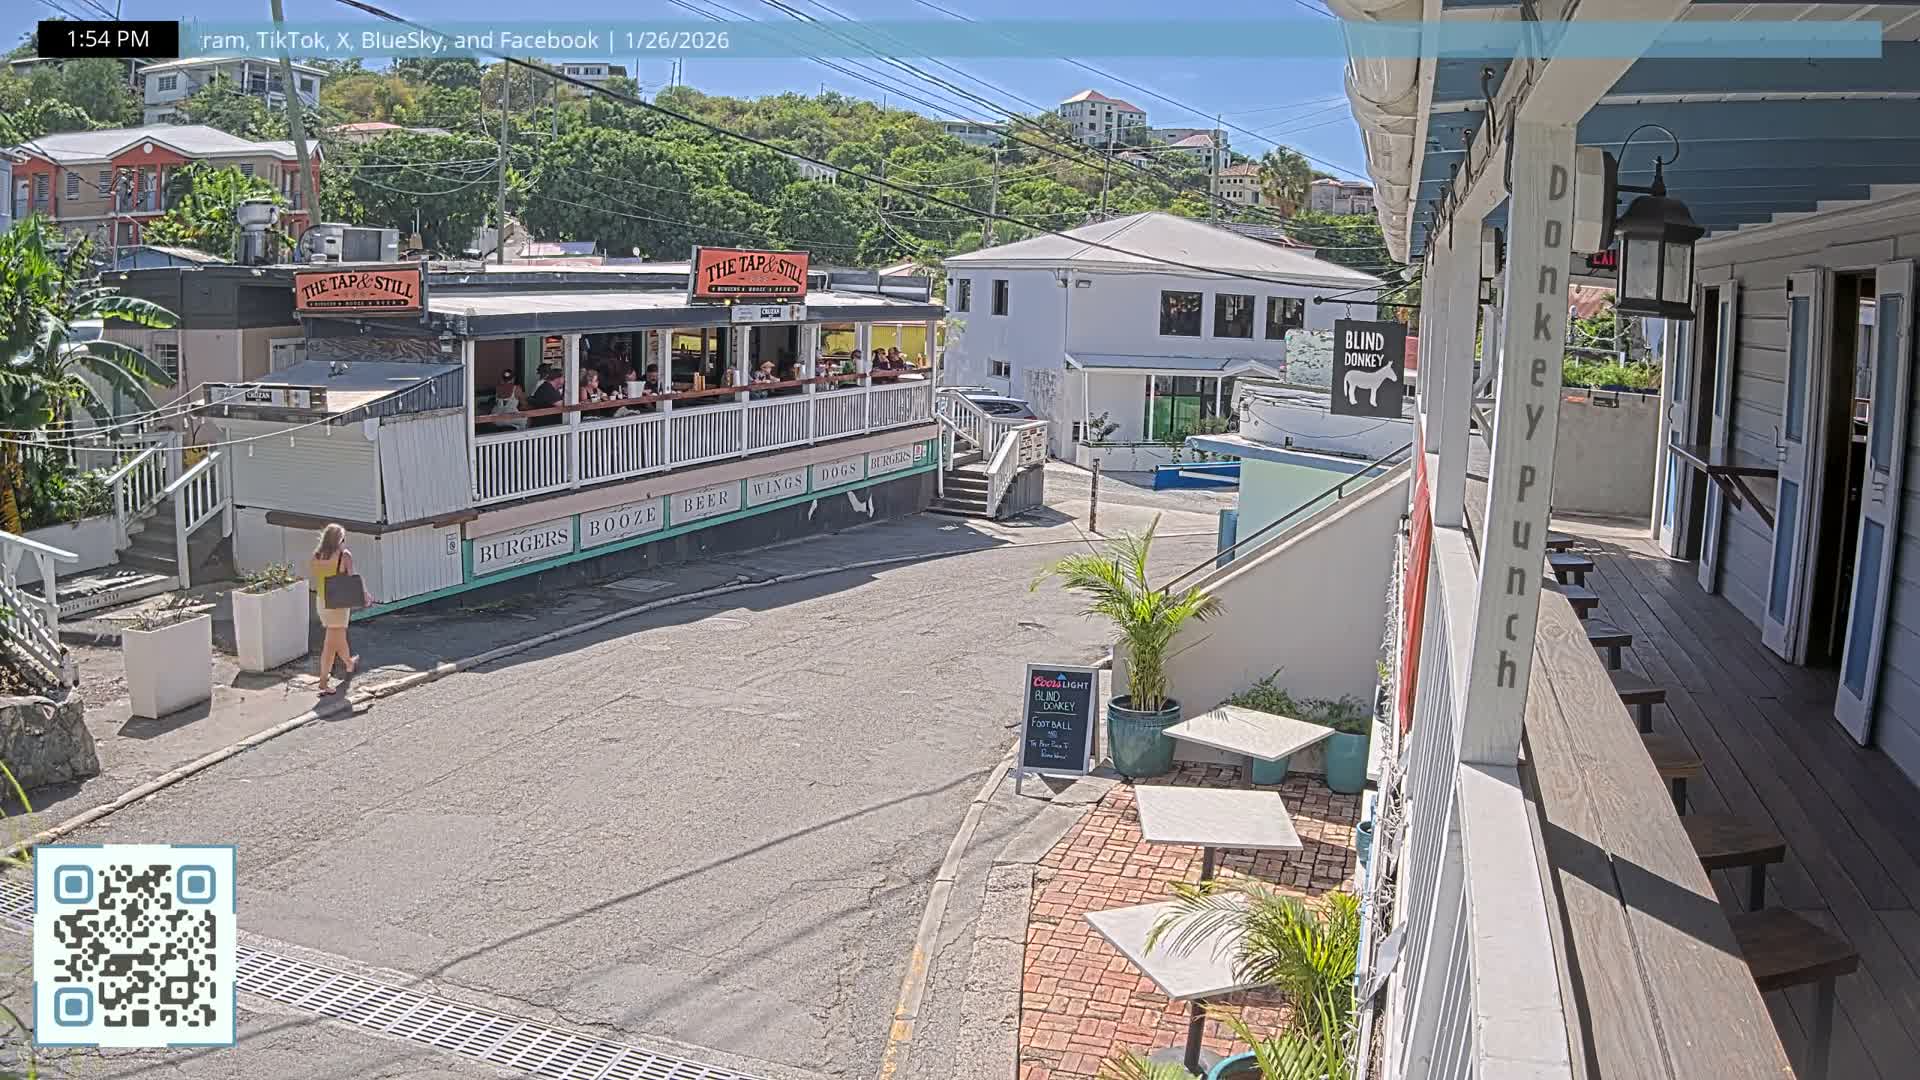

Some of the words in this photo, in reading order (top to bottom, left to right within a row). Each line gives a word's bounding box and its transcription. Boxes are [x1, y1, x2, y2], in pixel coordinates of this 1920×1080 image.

[706, 258, 737, 283] THE
[738, 255, 765, 273] TAP
[777, 259, 803, 285] STILL
[301, 279, 329, 300] THE
[329, 274, 358, 290] TAP
[374, 275, 414, 299] STILL
[1345, 330, 1385, 351] BLIND
[1344, 352, 1385, 368] DONKEY
[246, 391, 271, 399] CRUZAN
[870, 450, 912, 470] BURGERS
[821, 462, 857, 481] DOGS
[752, 475, 803, 497] WINGS
[683, 490, 729, 513] BEER
[589, 507, 657, 537] BOOZE
[479, 528, 569, 563] BURGERS
[1032, 675, 1061, 688] Coors
[1062, 681, 1089, 690] LIGHT
[1034, 690, 1061, 702] BLIND
[1043, 701, 1076, 712] DONKEY
